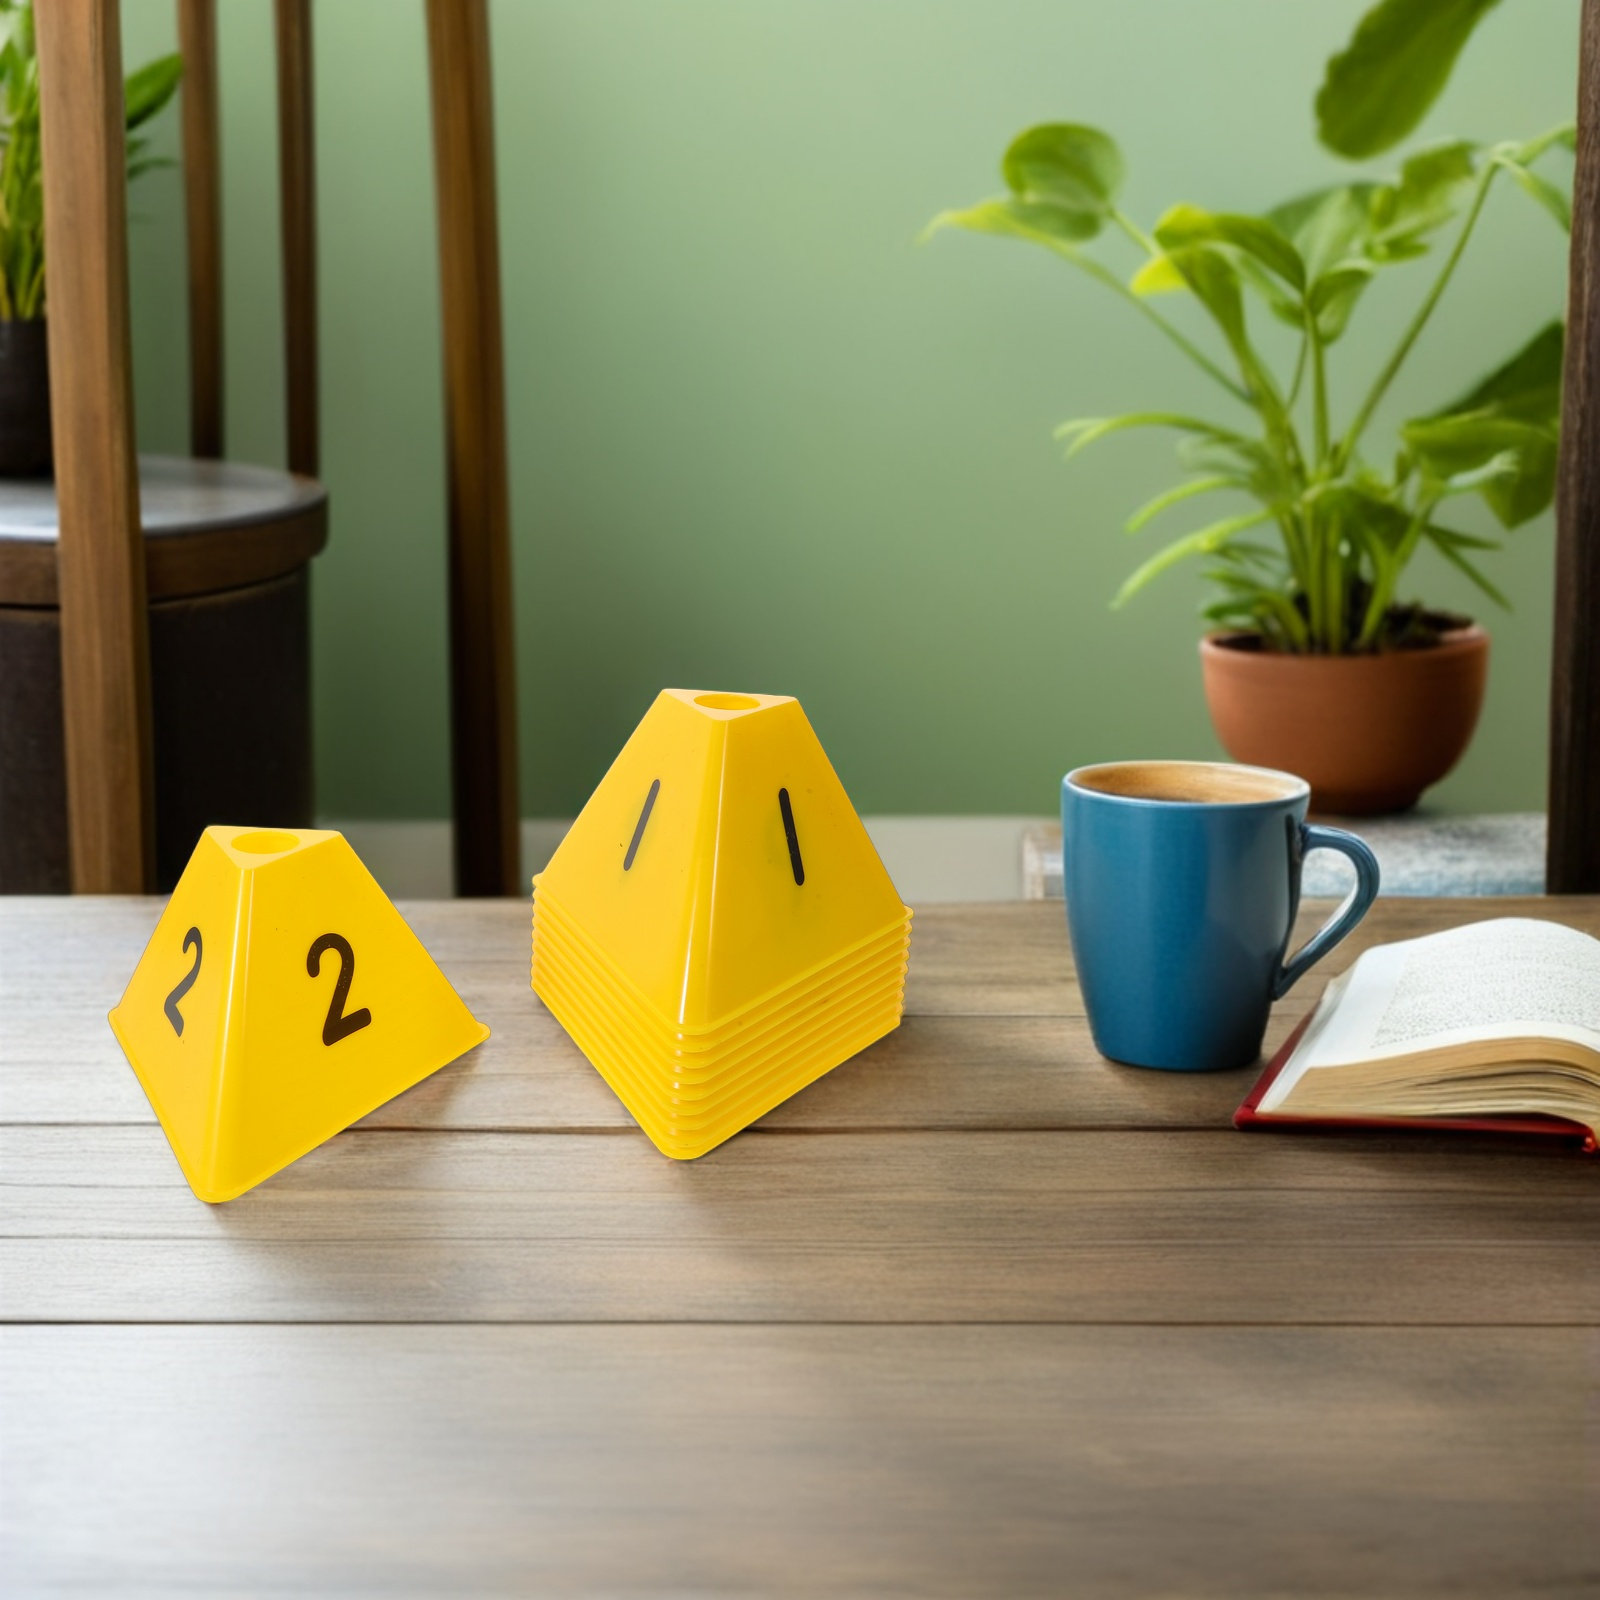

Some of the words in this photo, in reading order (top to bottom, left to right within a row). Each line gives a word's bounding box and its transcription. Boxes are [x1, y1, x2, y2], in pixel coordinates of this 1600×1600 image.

[623, 778, 661, 872] 1
[778, 787, 805, 887] 1
[163, 926, 203, 1038] 2
[306, 932, 372, 1047] 2
